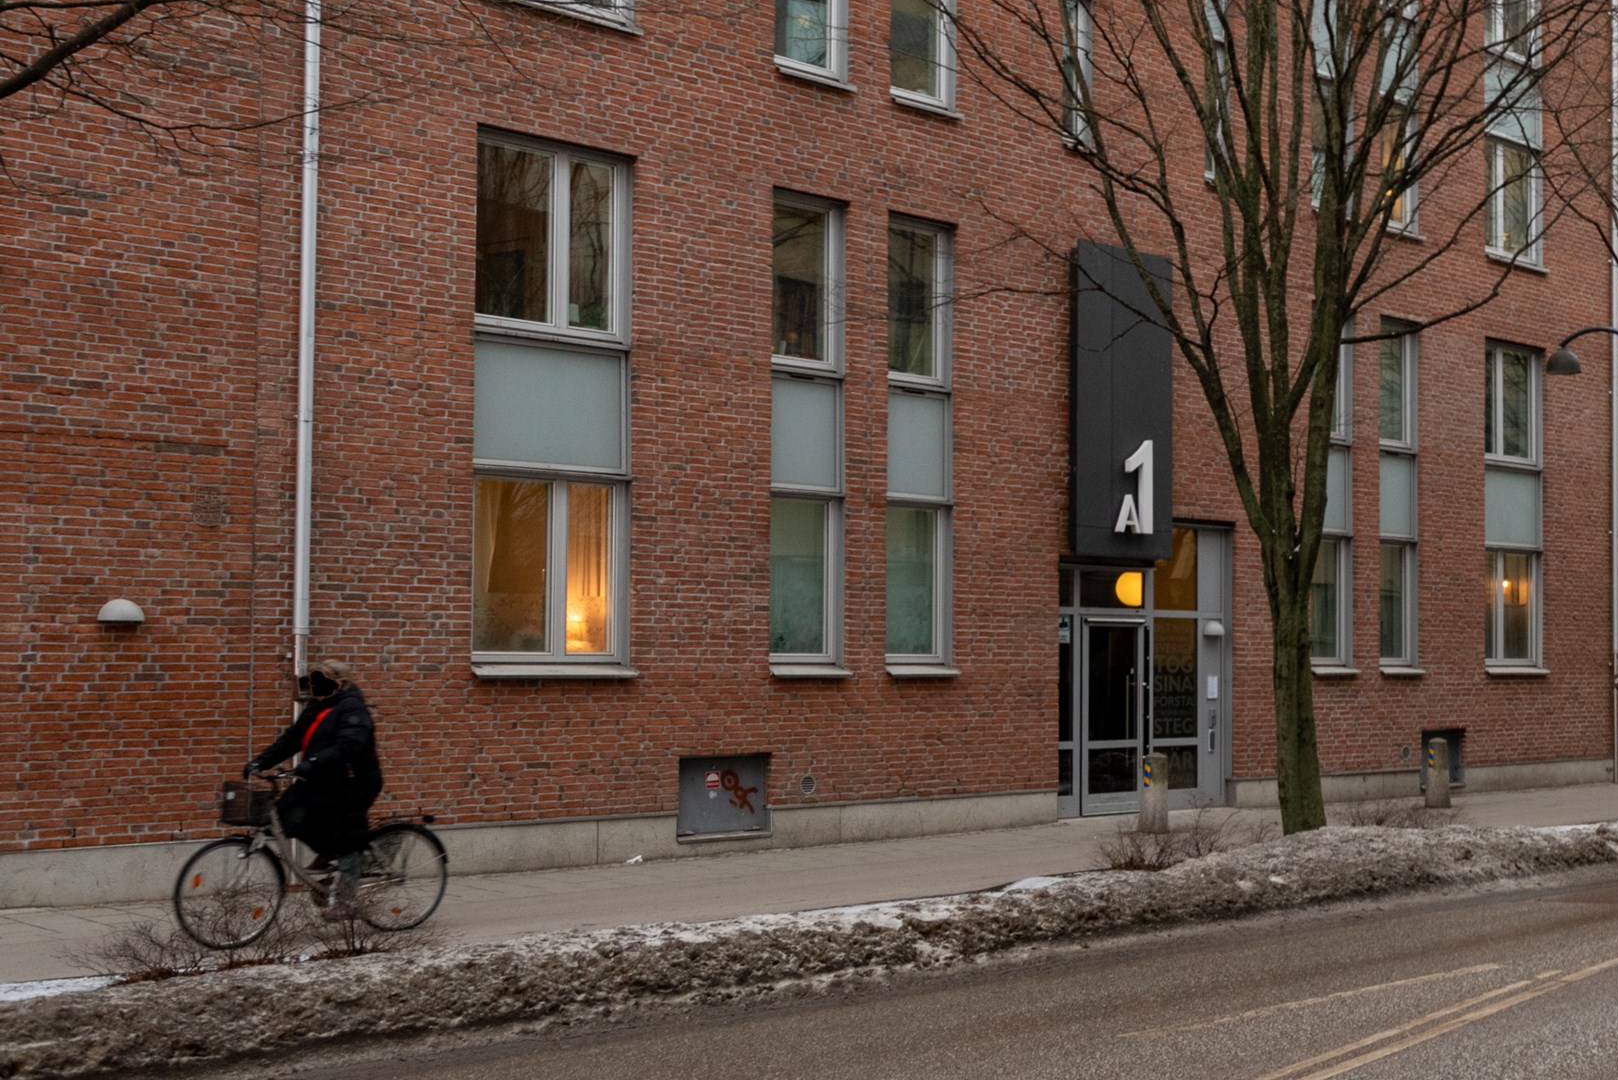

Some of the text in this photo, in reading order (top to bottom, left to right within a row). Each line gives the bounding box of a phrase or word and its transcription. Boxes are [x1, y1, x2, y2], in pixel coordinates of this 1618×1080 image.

[1124, 439, 1153, 534] 1
[1114, 493, 1142, 533] A
[1154, 655, 1193, 673] TOG
[1154, 675, 1193, 692] SINA
[1154, 718, 1193, 735] STEG
